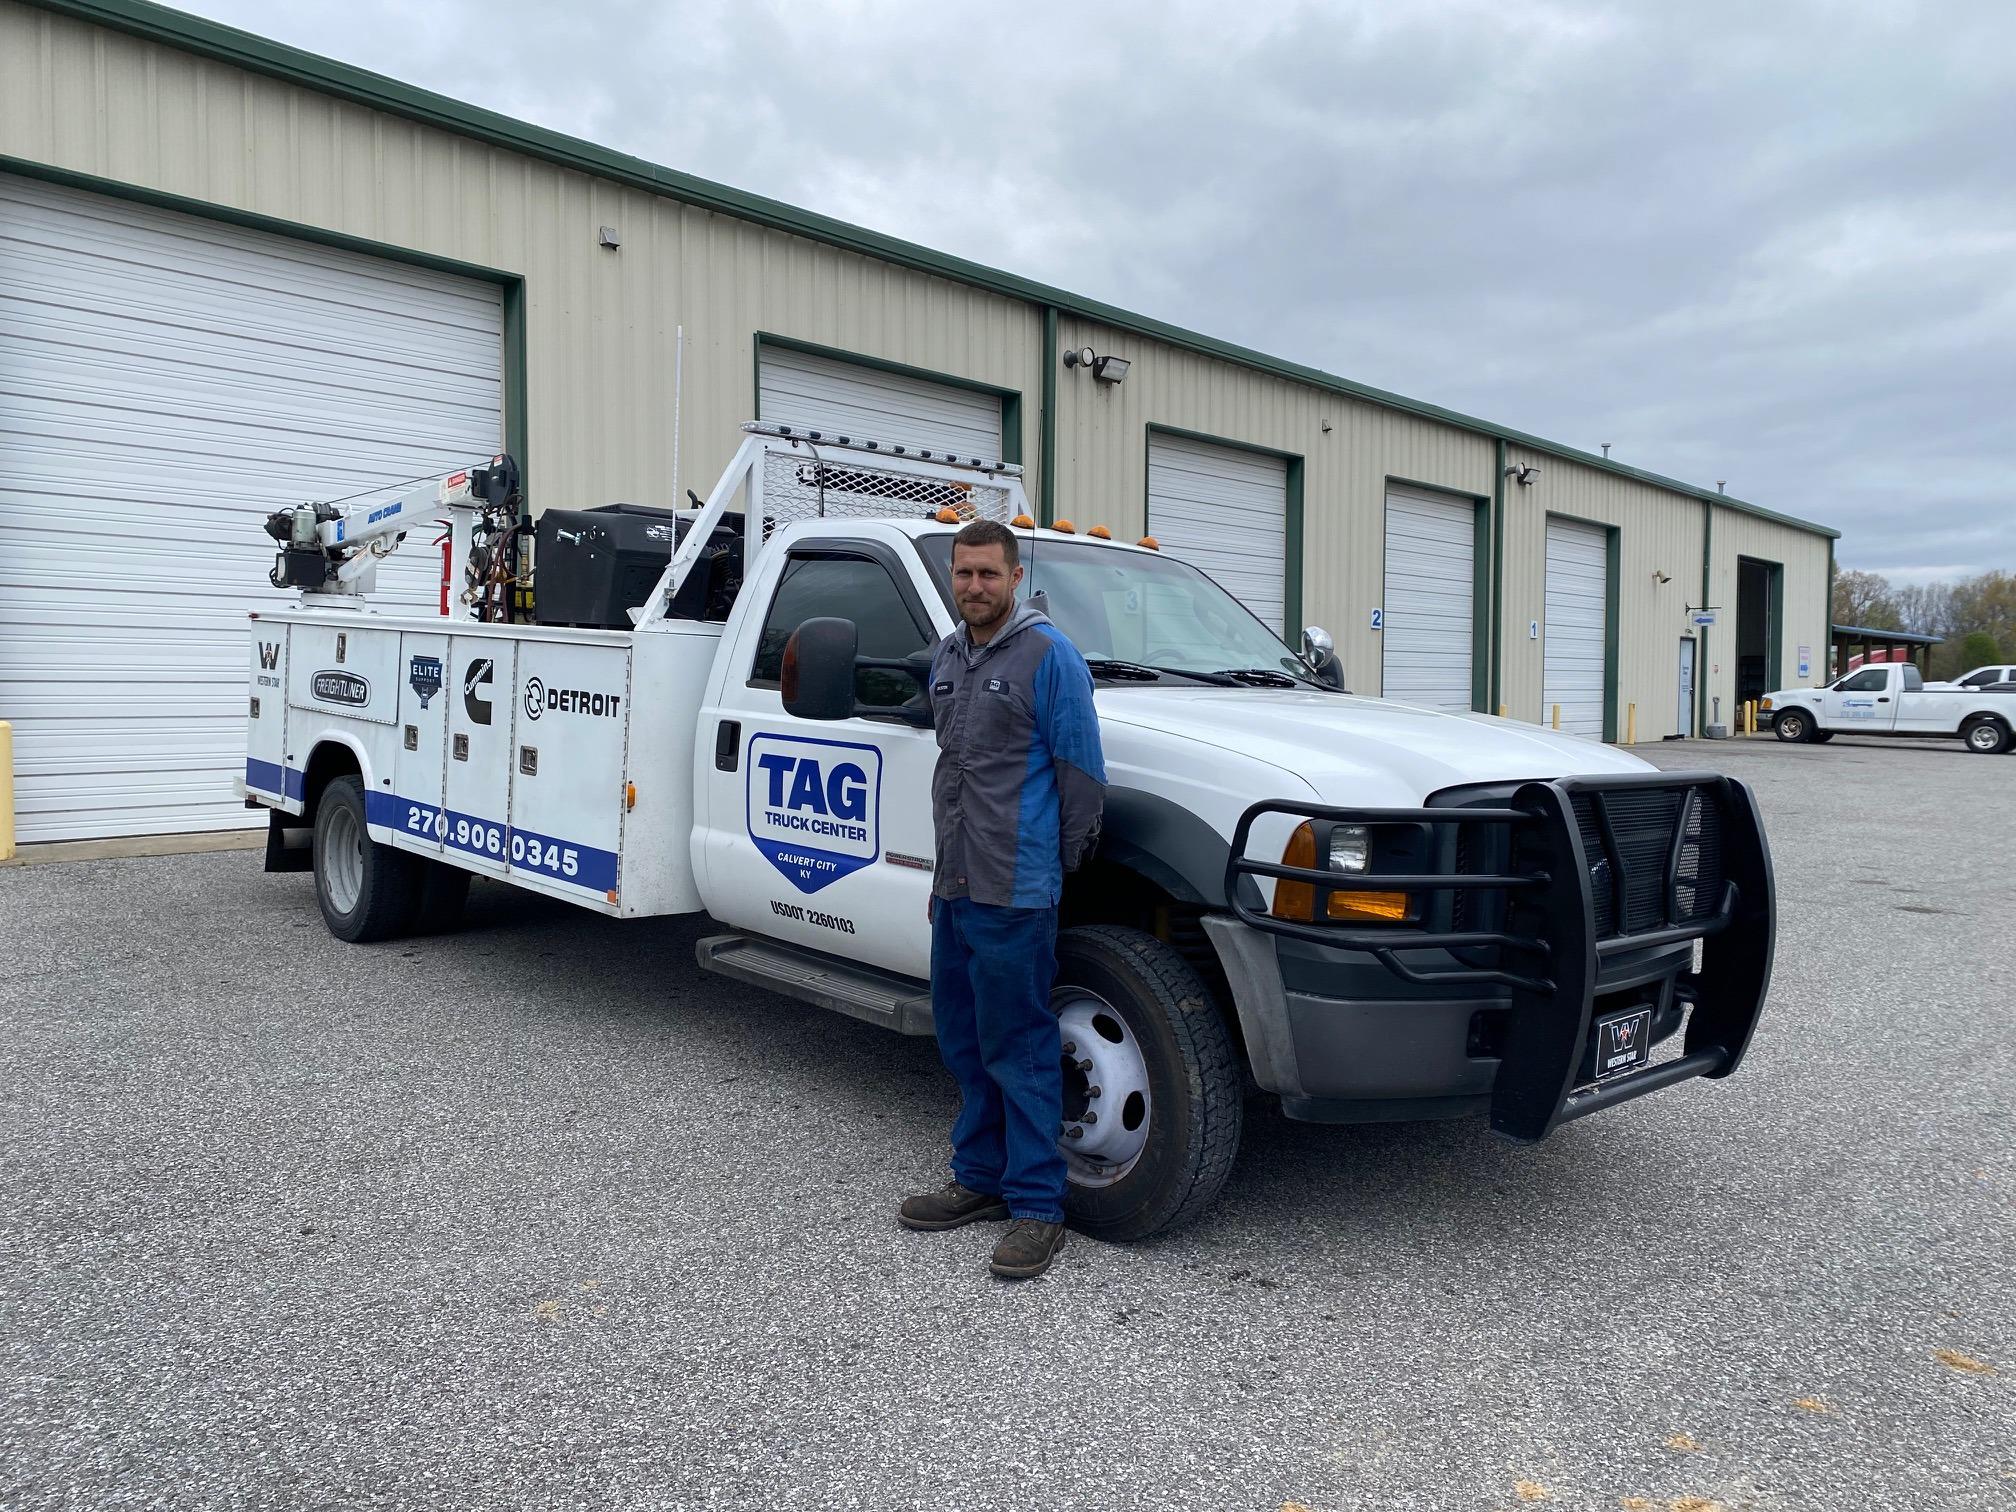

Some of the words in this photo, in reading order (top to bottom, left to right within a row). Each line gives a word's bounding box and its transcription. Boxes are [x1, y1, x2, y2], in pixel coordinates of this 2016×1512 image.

[1373, 610, 1381, 626] 2
[413, 664, 439, 678] ELITE
[464, 658, 492, 696] Cummins
[316, 678, 365, 700] FREIGHTLINER
[547, 688, 621, 718] DETROIT
[758, 753, 867, 822] TAG
[765, 811, 810, 832] TRUCK
[811, 819, 867, 842] CENTER
[407, 806, 579, 877] 270.906.0345
[777, 852, 816, 868] CALVERT
[816, 860, 838, 872] CITY
[800, 869, 811, 879] KY
[770, 900, 806, 922] USDOT
[807, 909, 855, 935] 2260103
[1607, 1054, 1626, 1069] WESTERN
[1627, 1051, 1637, 1063] STAR
